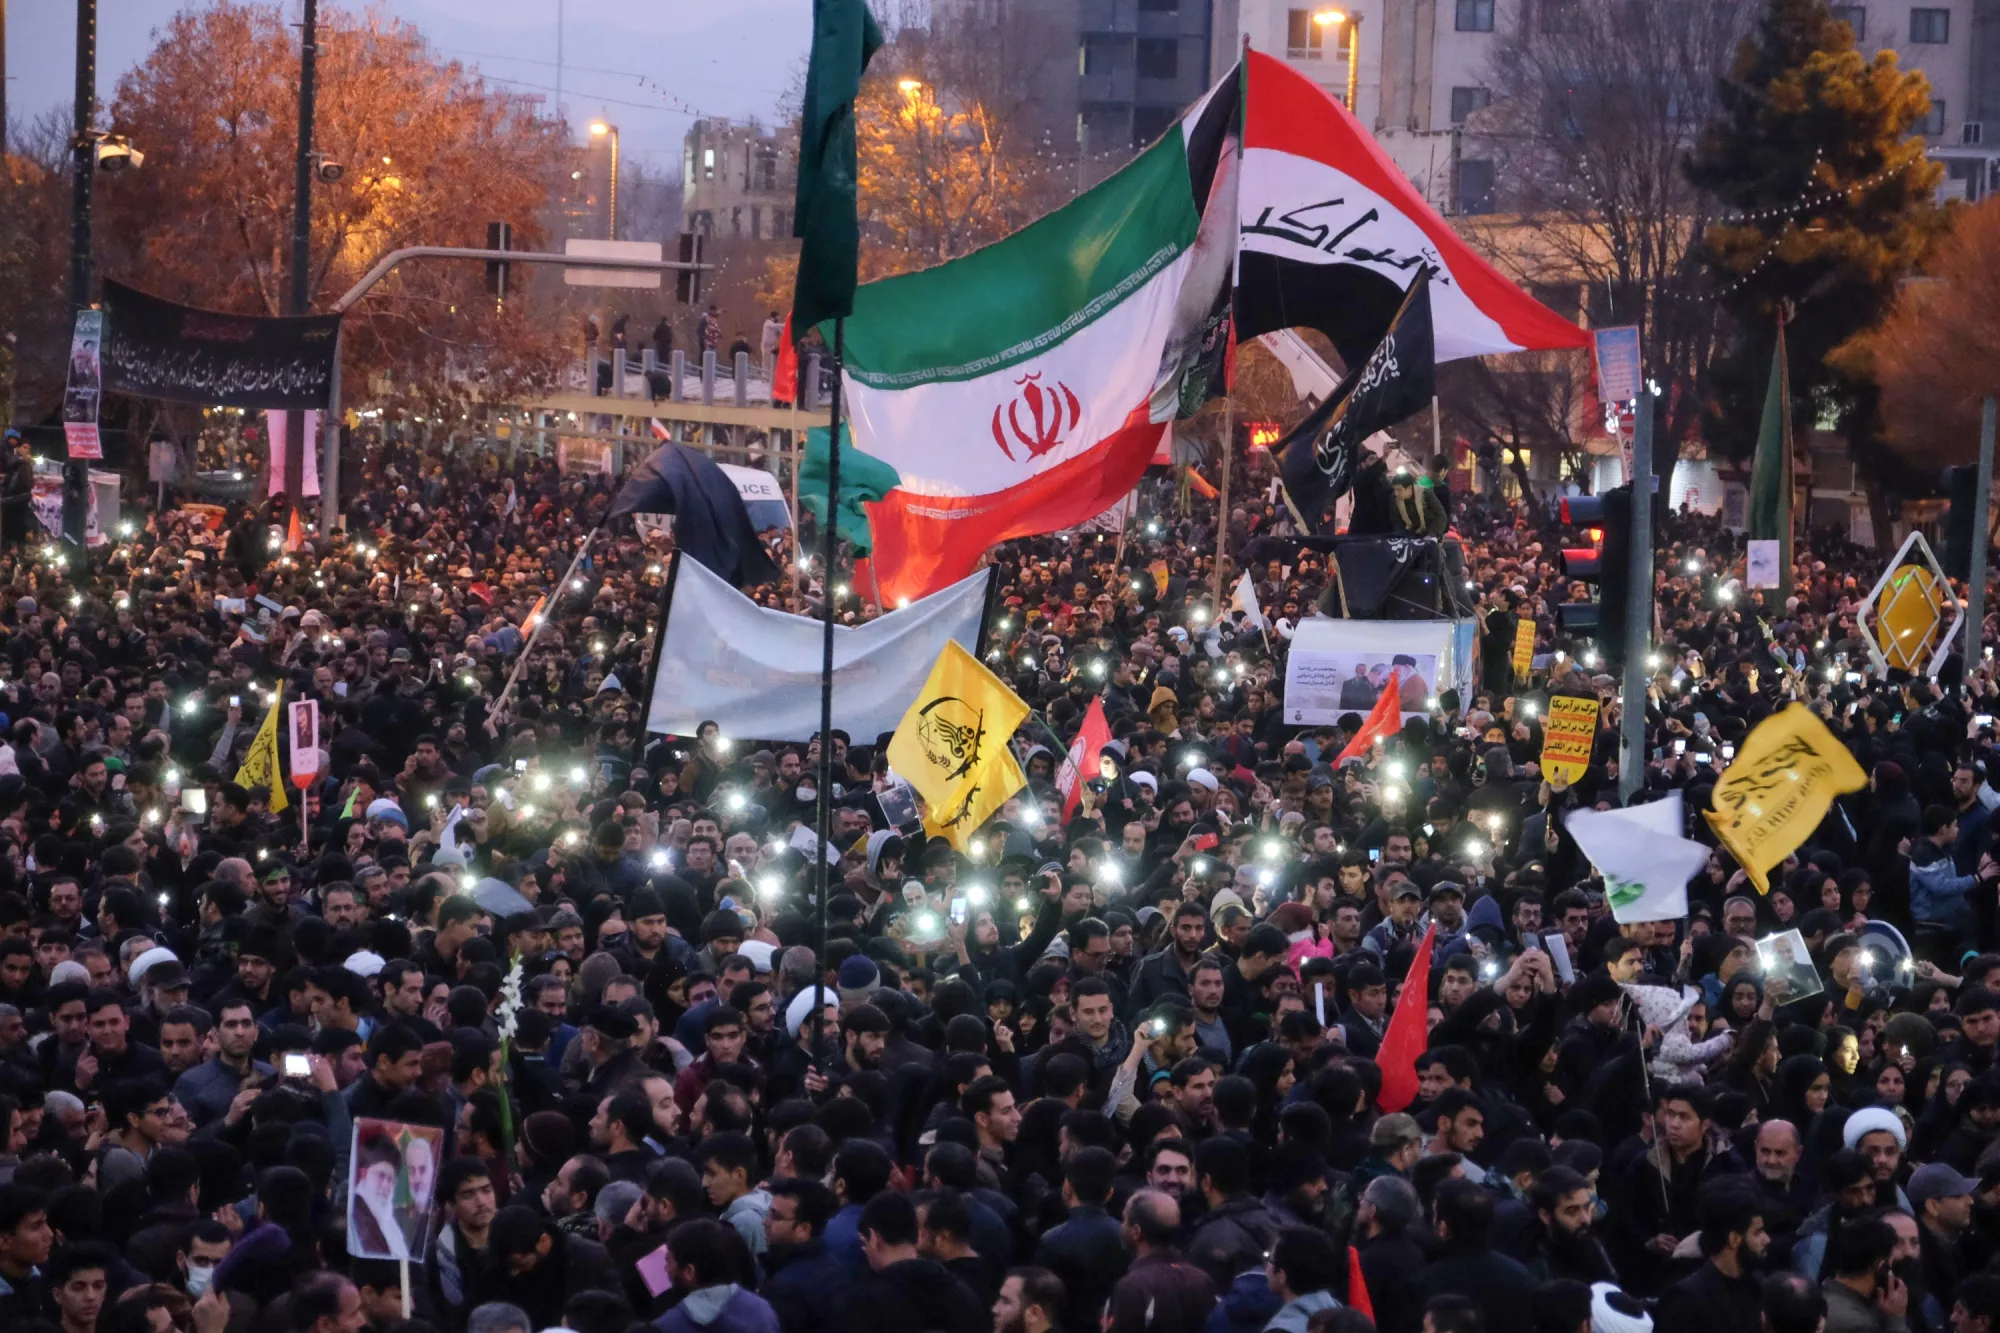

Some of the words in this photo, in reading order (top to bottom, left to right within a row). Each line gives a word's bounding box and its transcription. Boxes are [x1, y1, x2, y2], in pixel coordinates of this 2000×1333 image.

[1573, 703, 1581, 713] بر
[1581, 703, 1598, 715] مرگ
[1570, 725, 1577, 733] بر
[1579, 724, 1594, 735] مرگ
[1574, 745, 1590, 756] مرگ
